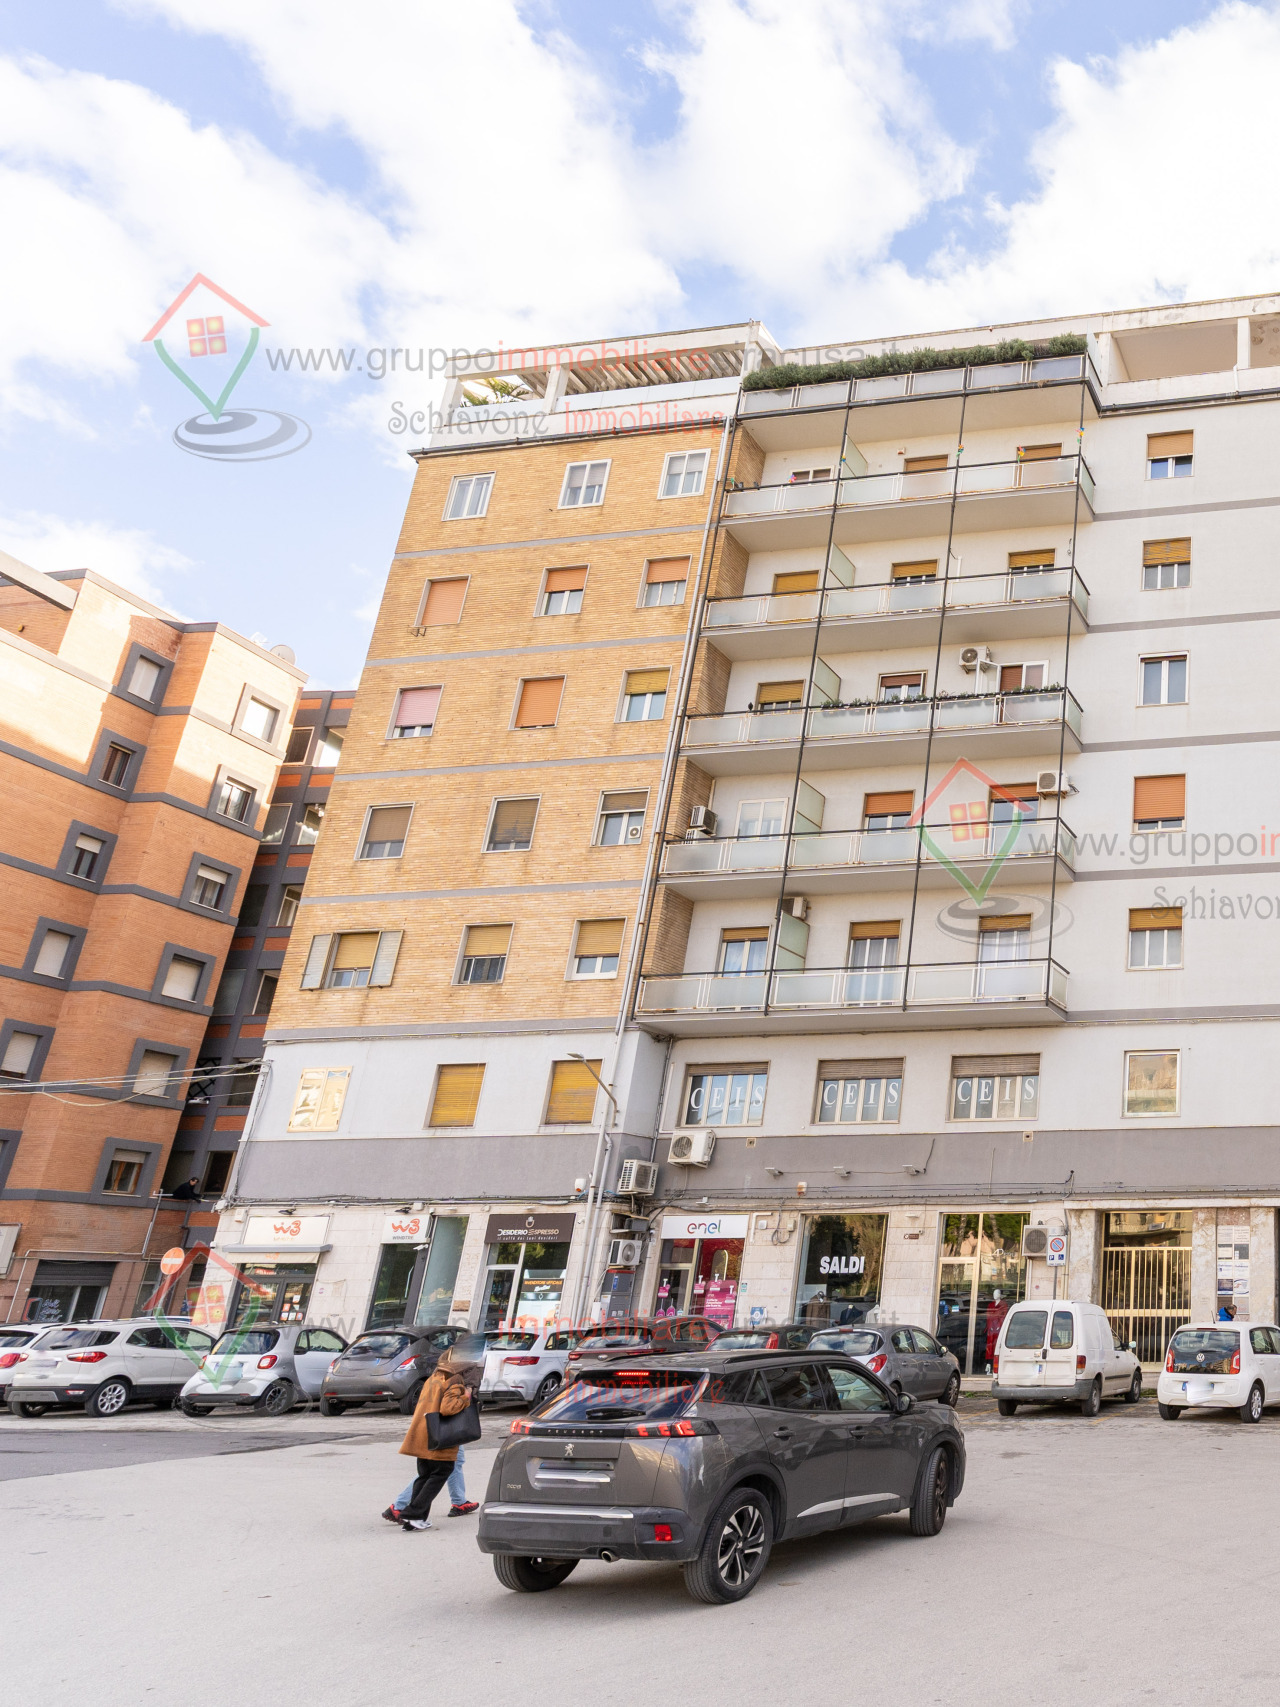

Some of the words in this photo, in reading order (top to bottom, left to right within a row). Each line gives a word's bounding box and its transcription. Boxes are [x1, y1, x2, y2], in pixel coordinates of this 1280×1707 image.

[690, 1086, 764, 1109] CEIS
[823, 1082, 899, 1105] CEIS
[957, 1078, 1035, 1102] CEIS
[497, 1228, 528, 1237] DESIDERIO
[687, 1219, 722, 1235] enel
[820, 1256, 865, 1274] SALDI
